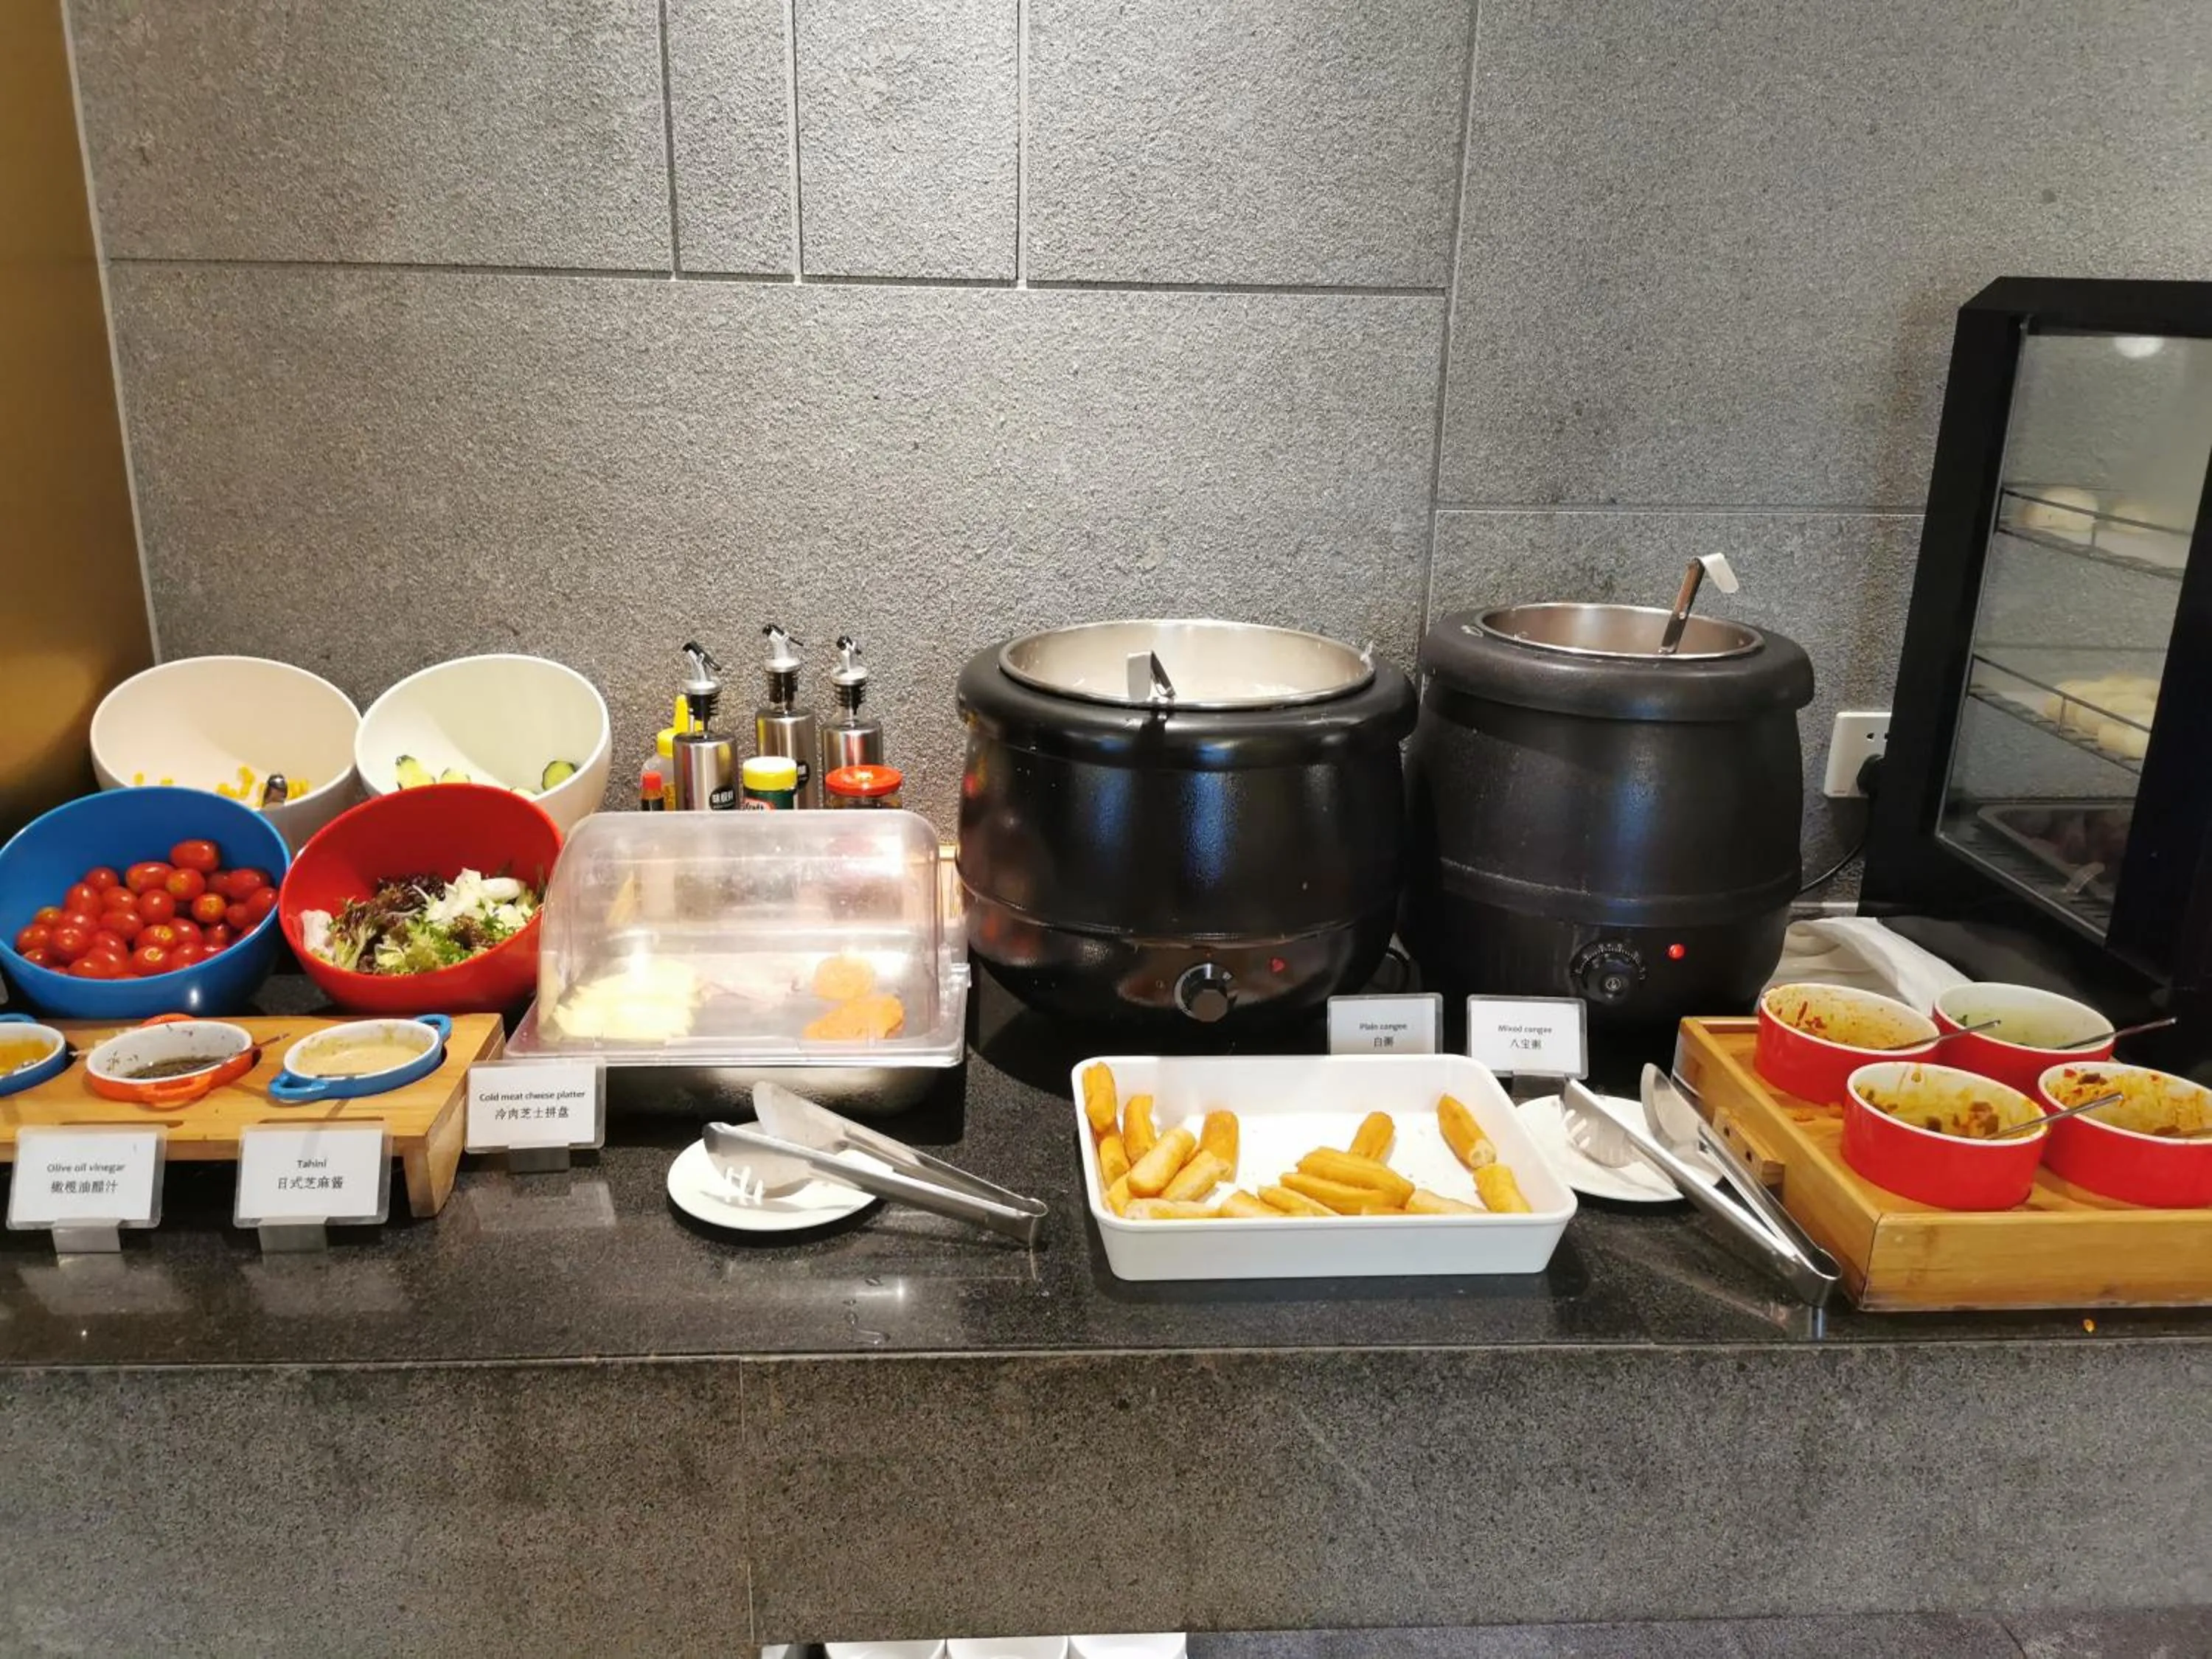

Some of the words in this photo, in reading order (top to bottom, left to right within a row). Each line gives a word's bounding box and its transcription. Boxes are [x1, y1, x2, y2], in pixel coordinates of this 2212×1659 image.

[1359, 1021, 1379, 1032] Plain
[1498, 1024, 1523, 1034] Mixed
[479, 1092, 500, 1102] Cold
[501, 1091, 524, 1102] meat
[525, 1091, 555, 1101] cheese
[556, 1088, 586, 1101] platter
[495, 1105, 569, 1121] 冷肉芝士拼盘
[46, 1162, 72, 1174] Olive
[74, 1162, 88, 1173] oil
[89, 1161, 125, 1175] vinegar
[296, 1158, 327, 1169] Tahini
